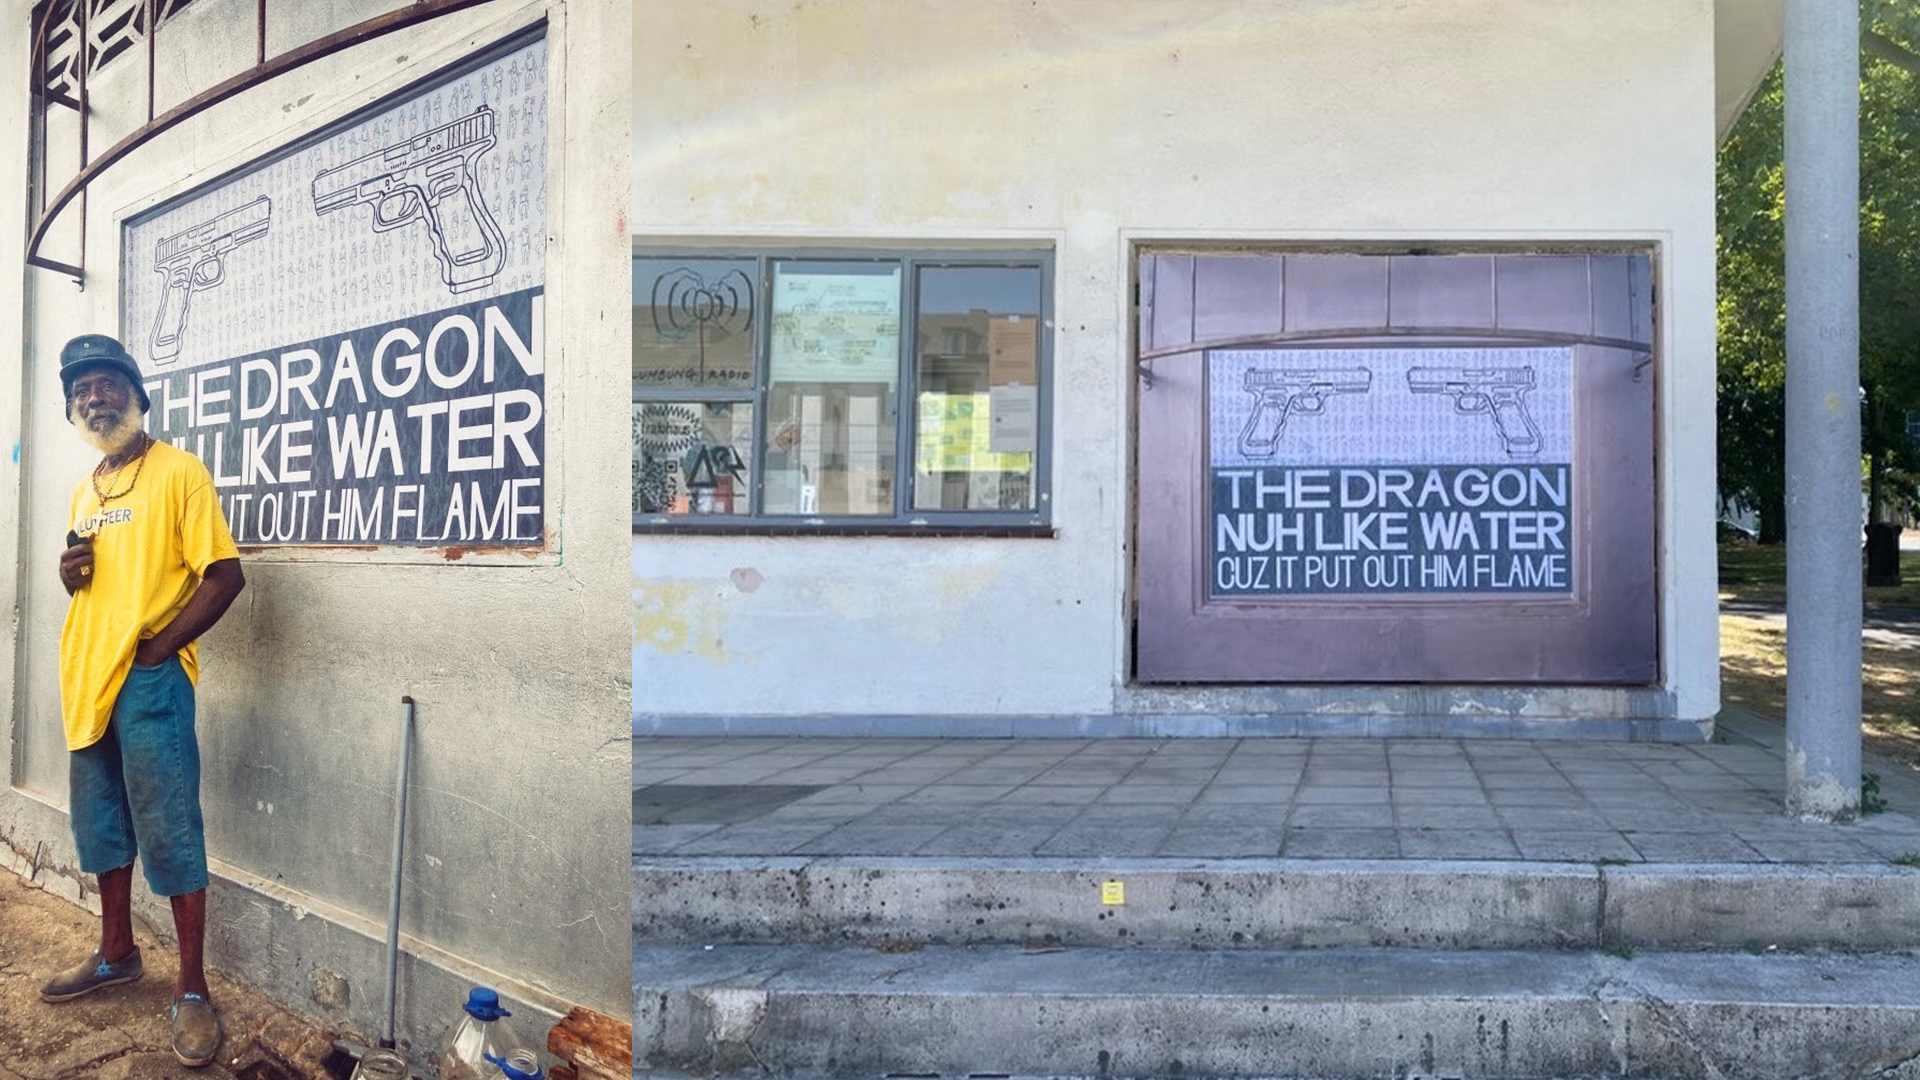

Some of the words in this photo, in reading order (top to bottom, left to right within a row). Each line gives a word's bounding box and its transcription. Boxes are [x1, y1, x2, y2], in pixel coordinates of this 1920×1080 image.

[240, 294, 544, 421] DRAGON
[708, 370, 751, 379] RADIO
[214, 420, 313, 488] LIKE
[327, 388, 543, 480] WATER
[1217, 469, 1331, 509] THE
[1340, 467, 1566, 508] DRAGON
[258, 490, 317, 541] OUT
[321, 486, 384, 541] HIM
[391, 478, 540, 541] FLAME
[1217, 513, 1304, 552] NUH
[1315, 512, 1408, 551] LIKE
[1421, 511, 1565, 551] WATER
[1217, 556, 1270, 589] CUZ
[1275, 556, 1298, 589] IT
[1305, 556, 1356, 588] PUT
[1363, 556, 1414, 588] OUT
[1421, 556, 1467, 588] HIM
[1474, 555, 1566, 588] FLAME
